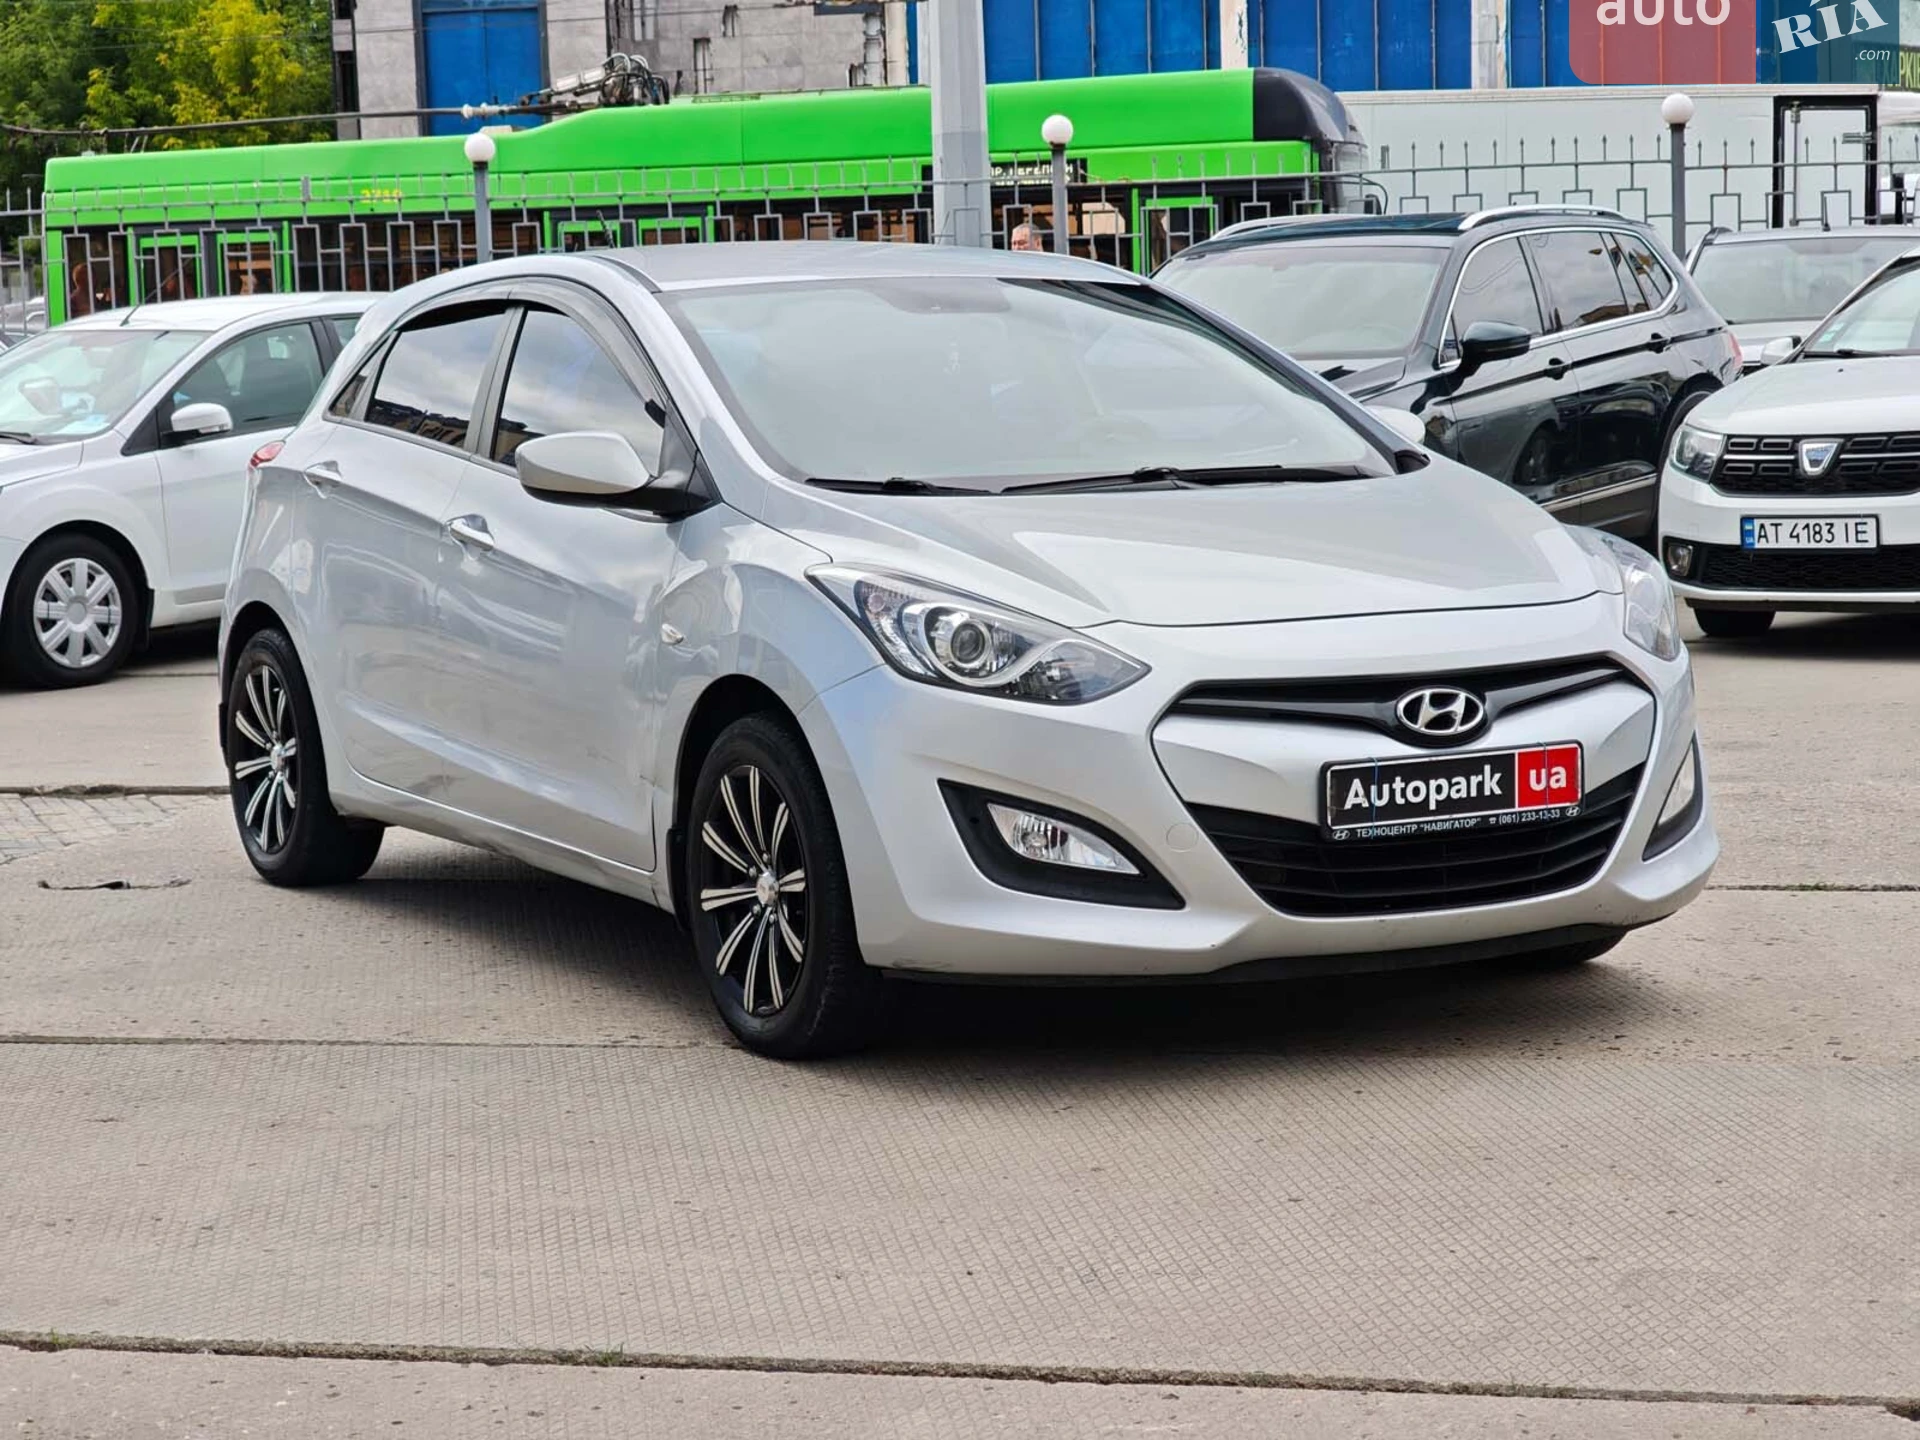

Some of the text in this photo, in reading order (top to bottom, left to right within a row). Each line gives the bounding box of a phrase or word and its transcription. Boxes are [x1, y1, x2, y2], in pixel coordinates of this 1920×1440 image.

[1757, 522, 1783, 544] AT
[1789, 522, 1836, 544] 4183
[1844, 521, 1870, 543] IE
[1344, 764, 1568, 811] Autopark ua
[1356, 825, 1418, 838] ТЕХНОЦЕНТР
[1499, 813, 1520, 826] (061)
[1521, 808, 1561, 822] 233-13-33
